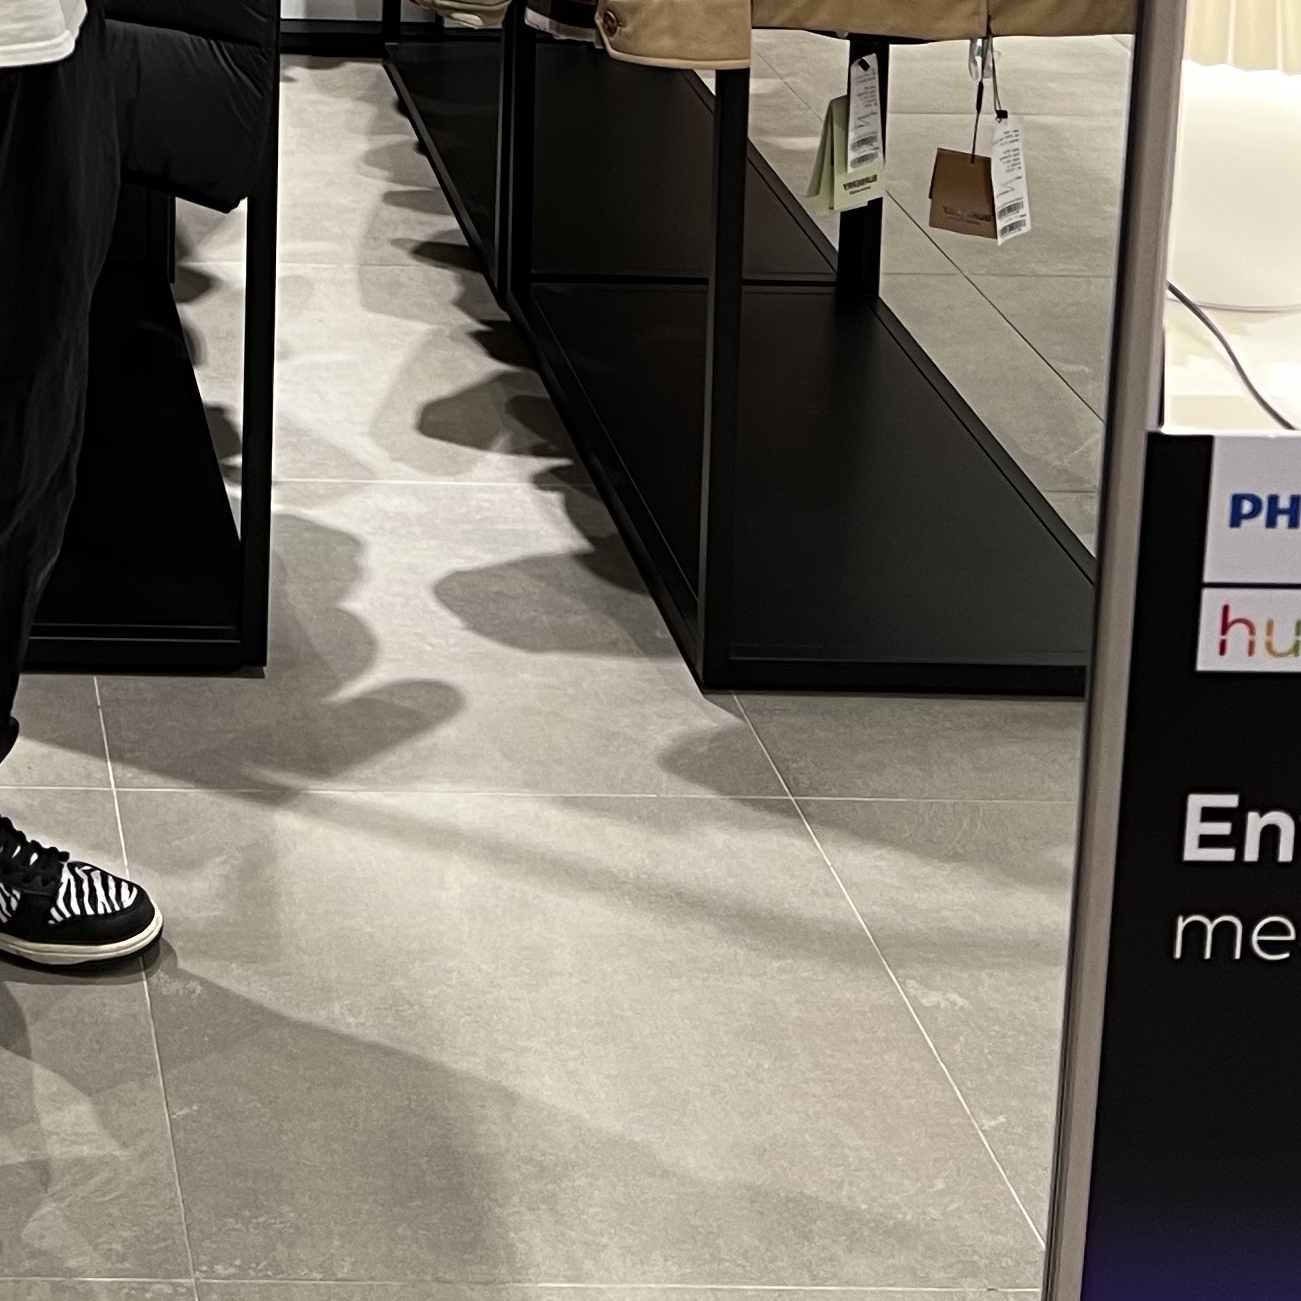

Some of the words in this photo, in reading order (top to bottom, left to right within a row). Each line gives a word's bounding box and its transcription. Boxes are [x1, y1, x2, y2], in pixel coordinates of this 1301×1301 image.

[1228, 493, 1301, 530] PH
[1218, 604, 1301, 658] hu
[1183, 793, 1296, 862] En
[1173, 914, 1297, 961] me
